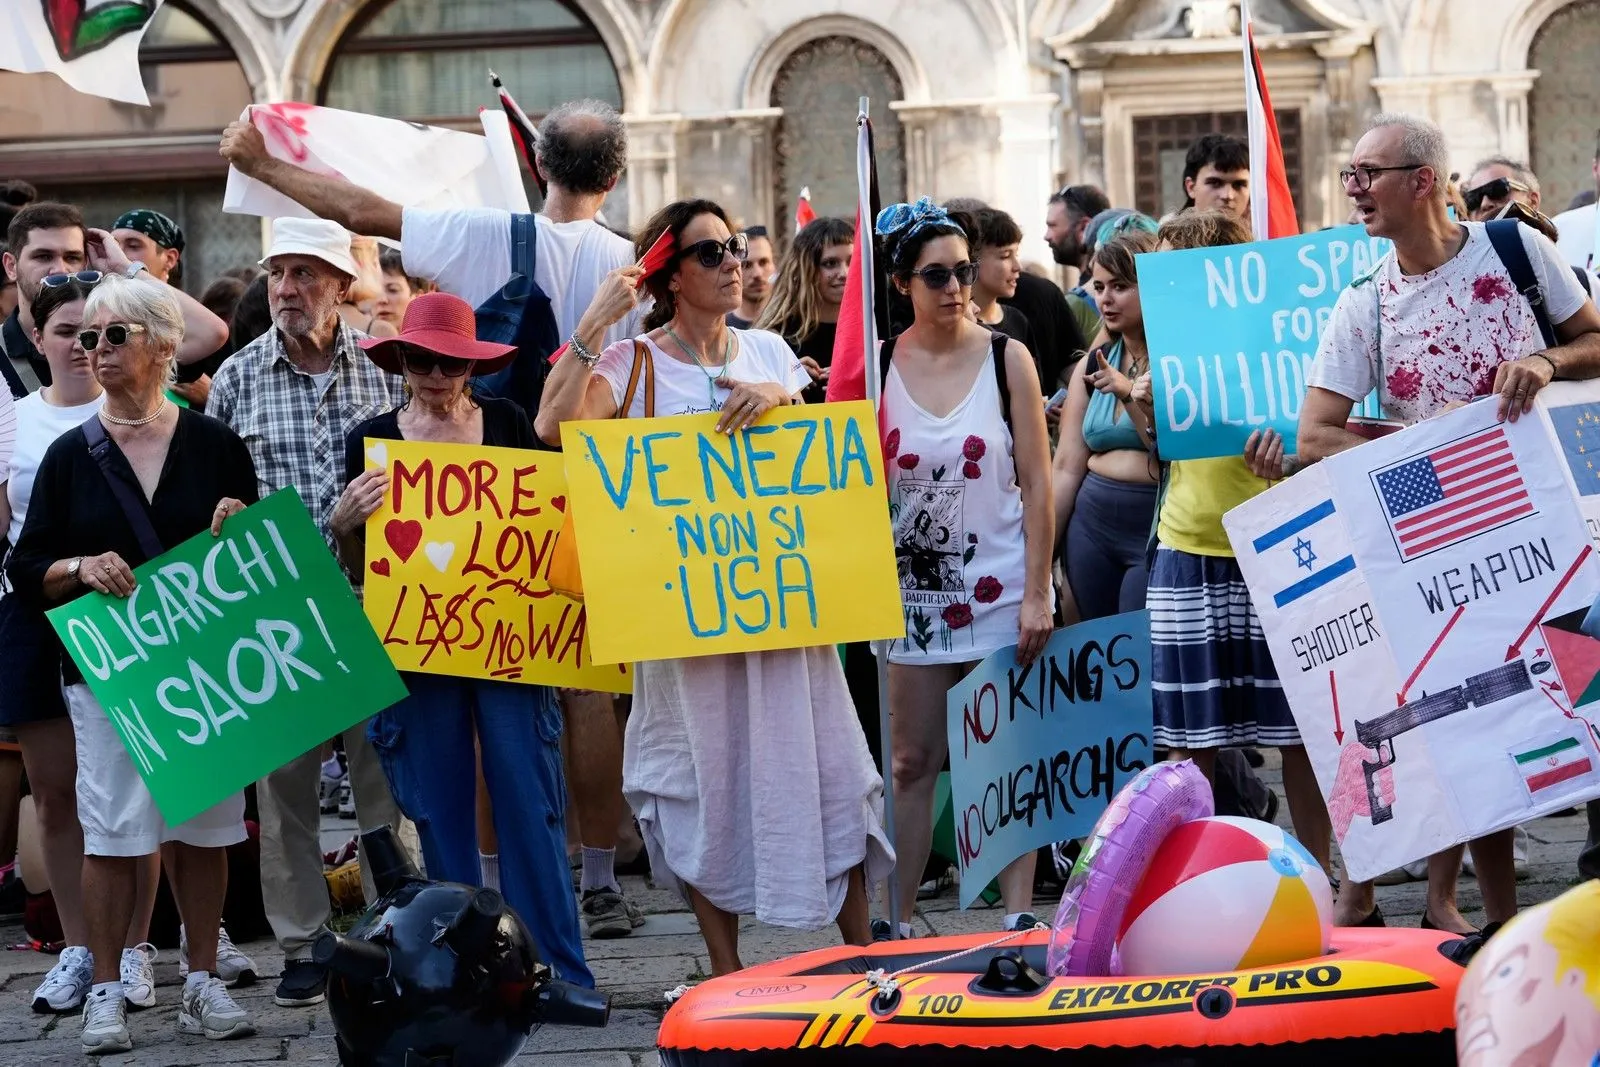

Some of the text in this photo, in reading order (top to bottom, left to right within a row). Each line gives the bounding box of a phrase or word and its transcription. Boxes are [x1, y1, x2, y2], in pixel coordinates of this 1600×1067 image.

[1204, 251, 1267, 308] NO
[392, 459, 541, 520] MORE
[585, 417, 873, 510] VENEZIA
[462, 521, 560, 581] LOV
[675, 505, 806, 558] NON SI
[67, 519, 300, 681] OLIGARCHI
[679, 553, 818, 638] USA
[905, 592, 960, 605] PARTIGIANA
[1417, 537, 1556, 614] WEAPON
[1291, 602, 1381, 672] SHOOTER
[963, 634, 1140, 759] NO KINGS
[109, 698, 168, 777] IN
[957, 733, 1148, 877] NO OLIGARCHS
[750, 984, 792, 995] INTEX
[917, 994, 964, 1015] 100
[1248, 965, 1342, 992] PRO
